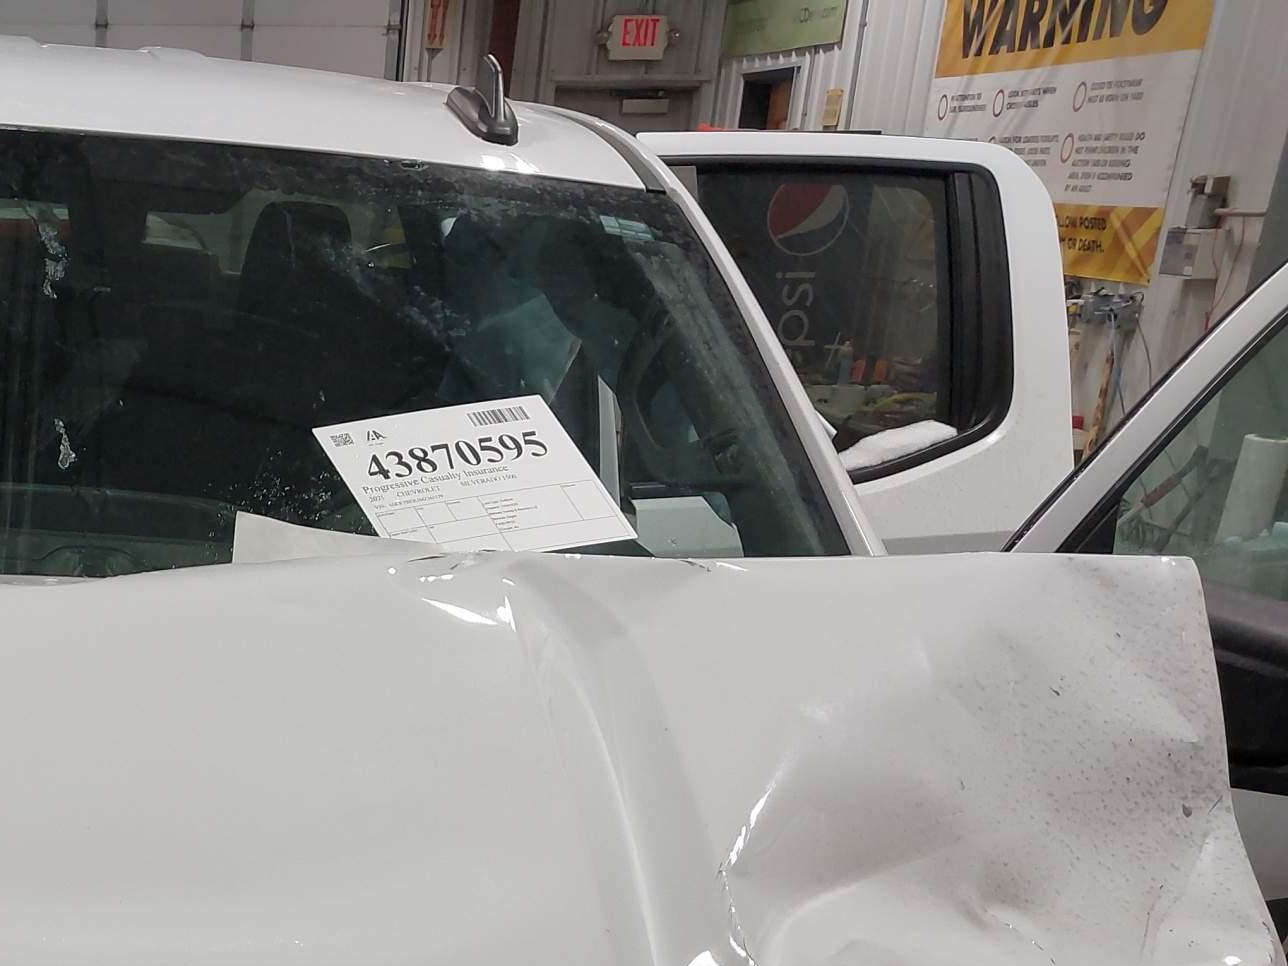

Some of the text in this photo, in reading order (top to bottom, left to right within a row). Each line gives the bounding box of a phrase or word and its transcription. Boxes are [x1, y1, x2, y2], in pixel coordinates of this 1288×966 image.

[622, 18, 660, 47] EXIT
[961, 0, 1168, 59] WARNING
[1079, 216, 1107, 231] POSTED
[1078, 239, 1104, 253] DEATH.
[368, 430, 548, 480] 43870595
[362, 465, 509, 495] Progressive Casualty Insurance
[396, 486, 441, 498] CHEVROLET
[460, 476, 502, 488] SILVERADO
